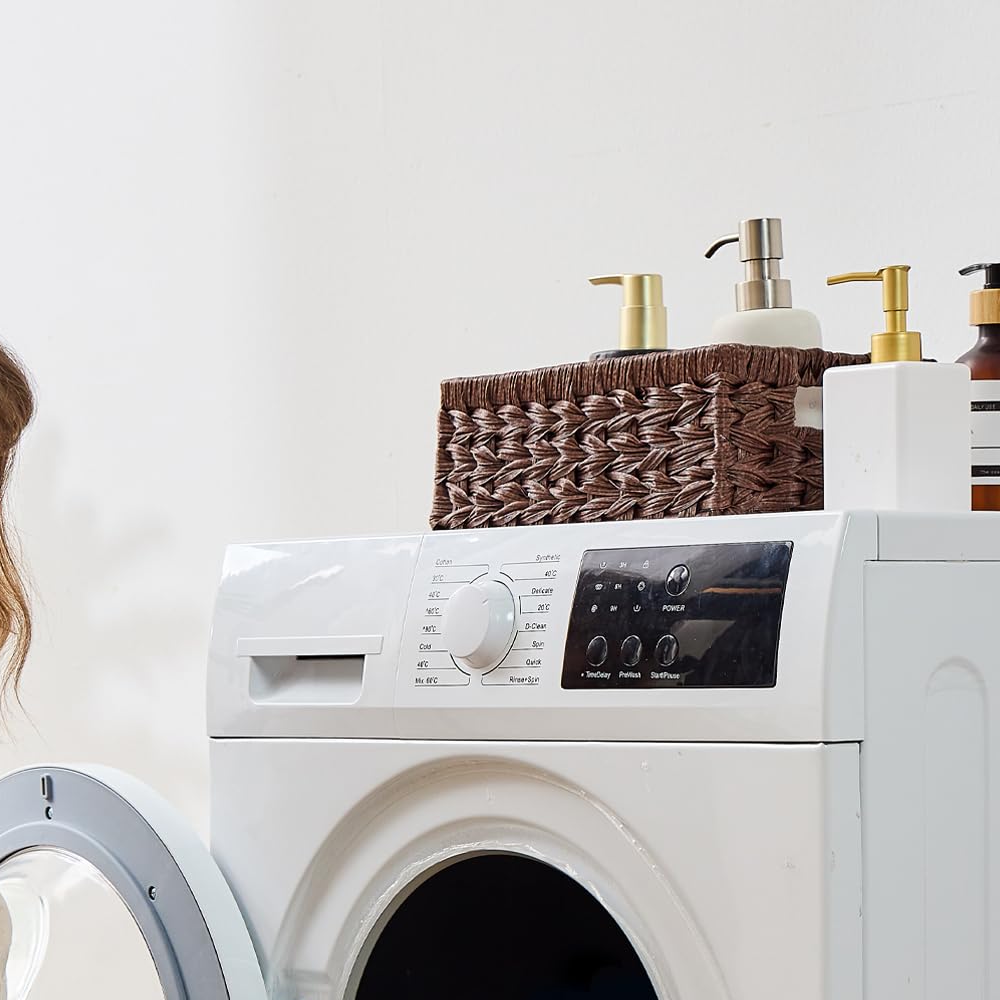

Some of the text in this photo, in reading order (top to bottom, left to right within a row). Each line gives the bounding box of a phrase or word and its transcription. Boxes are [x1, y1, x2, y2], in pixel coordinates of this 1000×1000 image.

[544, 569, 557, 577] 40°C
[531, 587, 554, 595] Delicate
[537, 603, 551, 611] 20°C
[662, 604, 686, 613] POWER
[524, 622, 547, 630] D-Clean
[531, 640, 545, 648] Spin
[525, 658, 542, 666] Quick
[509, 675, 540, 683] Rinse+Spin
